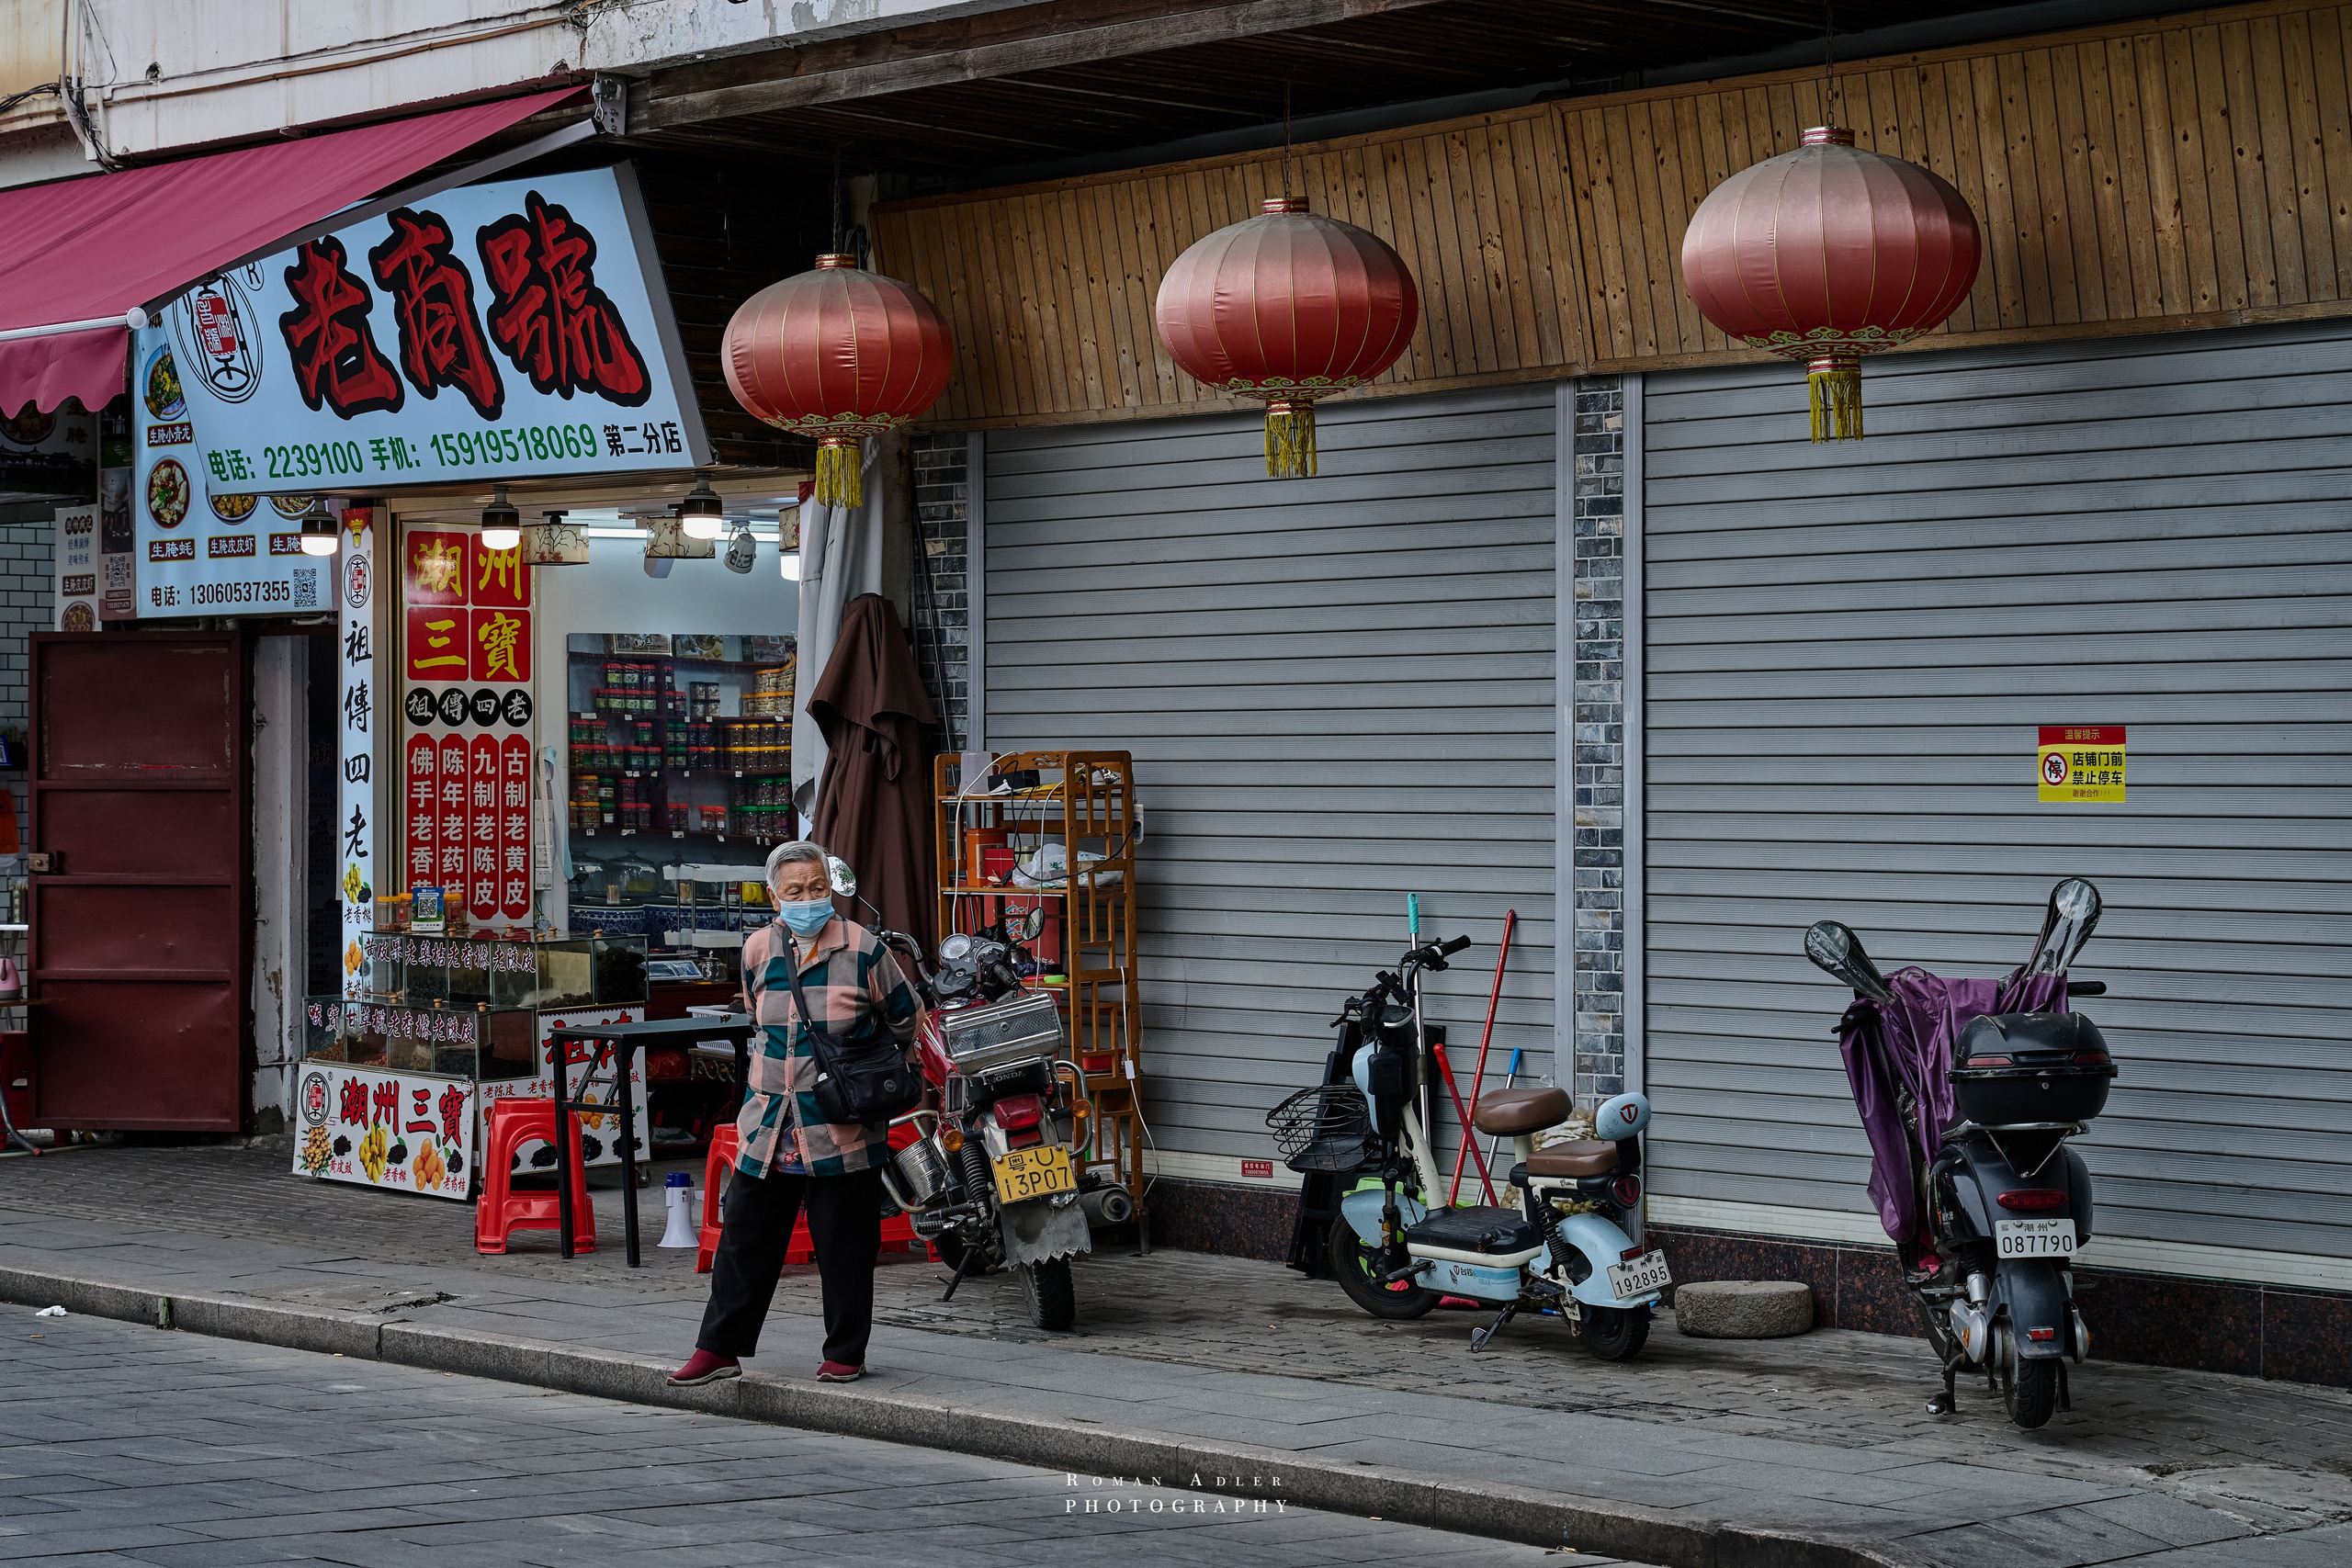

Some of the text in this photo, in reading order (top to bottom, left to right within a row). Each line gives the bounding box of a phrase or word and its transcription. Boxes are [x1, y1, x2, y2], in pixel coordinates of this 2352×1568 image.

[264, 439, 364, 479] 2239100
[430, 423, 597, 467] 15919518069
[603, 421, 683, 457] 第二分店
[151, 542, 194, 558] 生腌蚝
[210, 537, 254, 555] 生腌皮皮虾
[271, 536, 301, 553] 生腌
[413, 538, 523, 601] 潮州
[189, 581, 290, 604] 13060537355
[413, 612, 523, 680] 三寶
[408, 688, 528, 723] 祖傳四老
[345, 620, 373, 859] 祖傳四老
[2064, 728, 2100, 740] 温馨提示
[2072, 751, 2123, 767] 店铺门前
[2072, 771, 2123, 785] 禁止停车
[472, 747, 496, 906] 九制老陈皮
[503, 747, 527, 906] 古制老黄皮
[483, 1083, 516, 1100] 老陈皮
[340, 1076, 466, 1149] 潮州三寶
[1004, 1166, 1069, 1200] 13P07
[2023, 1223, 2049, 1232] 潮州
[2003, 1235, 2073, 1254] 087790
[1615, 1266, 1668, 1295] 192895
